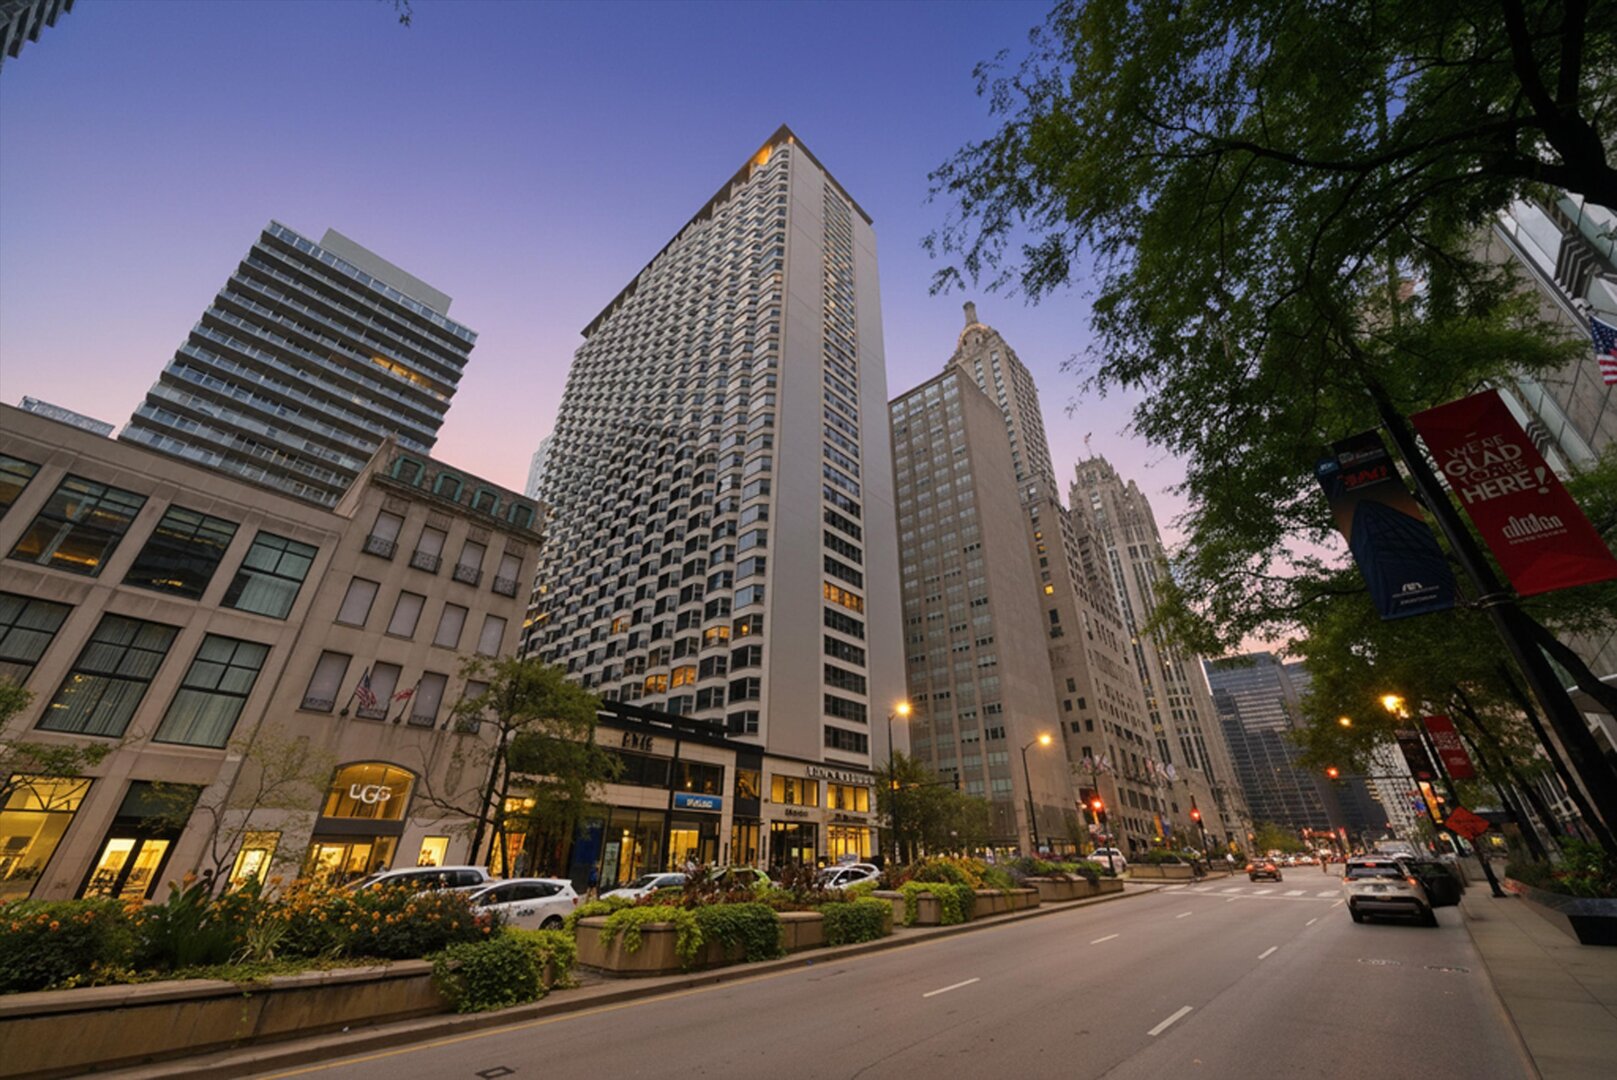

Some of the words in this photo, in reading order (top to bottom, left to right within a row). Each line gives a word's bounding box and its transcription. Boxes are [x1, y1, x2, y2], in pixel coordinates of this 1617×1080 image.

[1444, 444, 1522, 476] GLAD
[1445, 434, 1505, 458] WERE
[1461, 466, 1550, 504] HERE!
[349, 784, 392, 804] UGG
